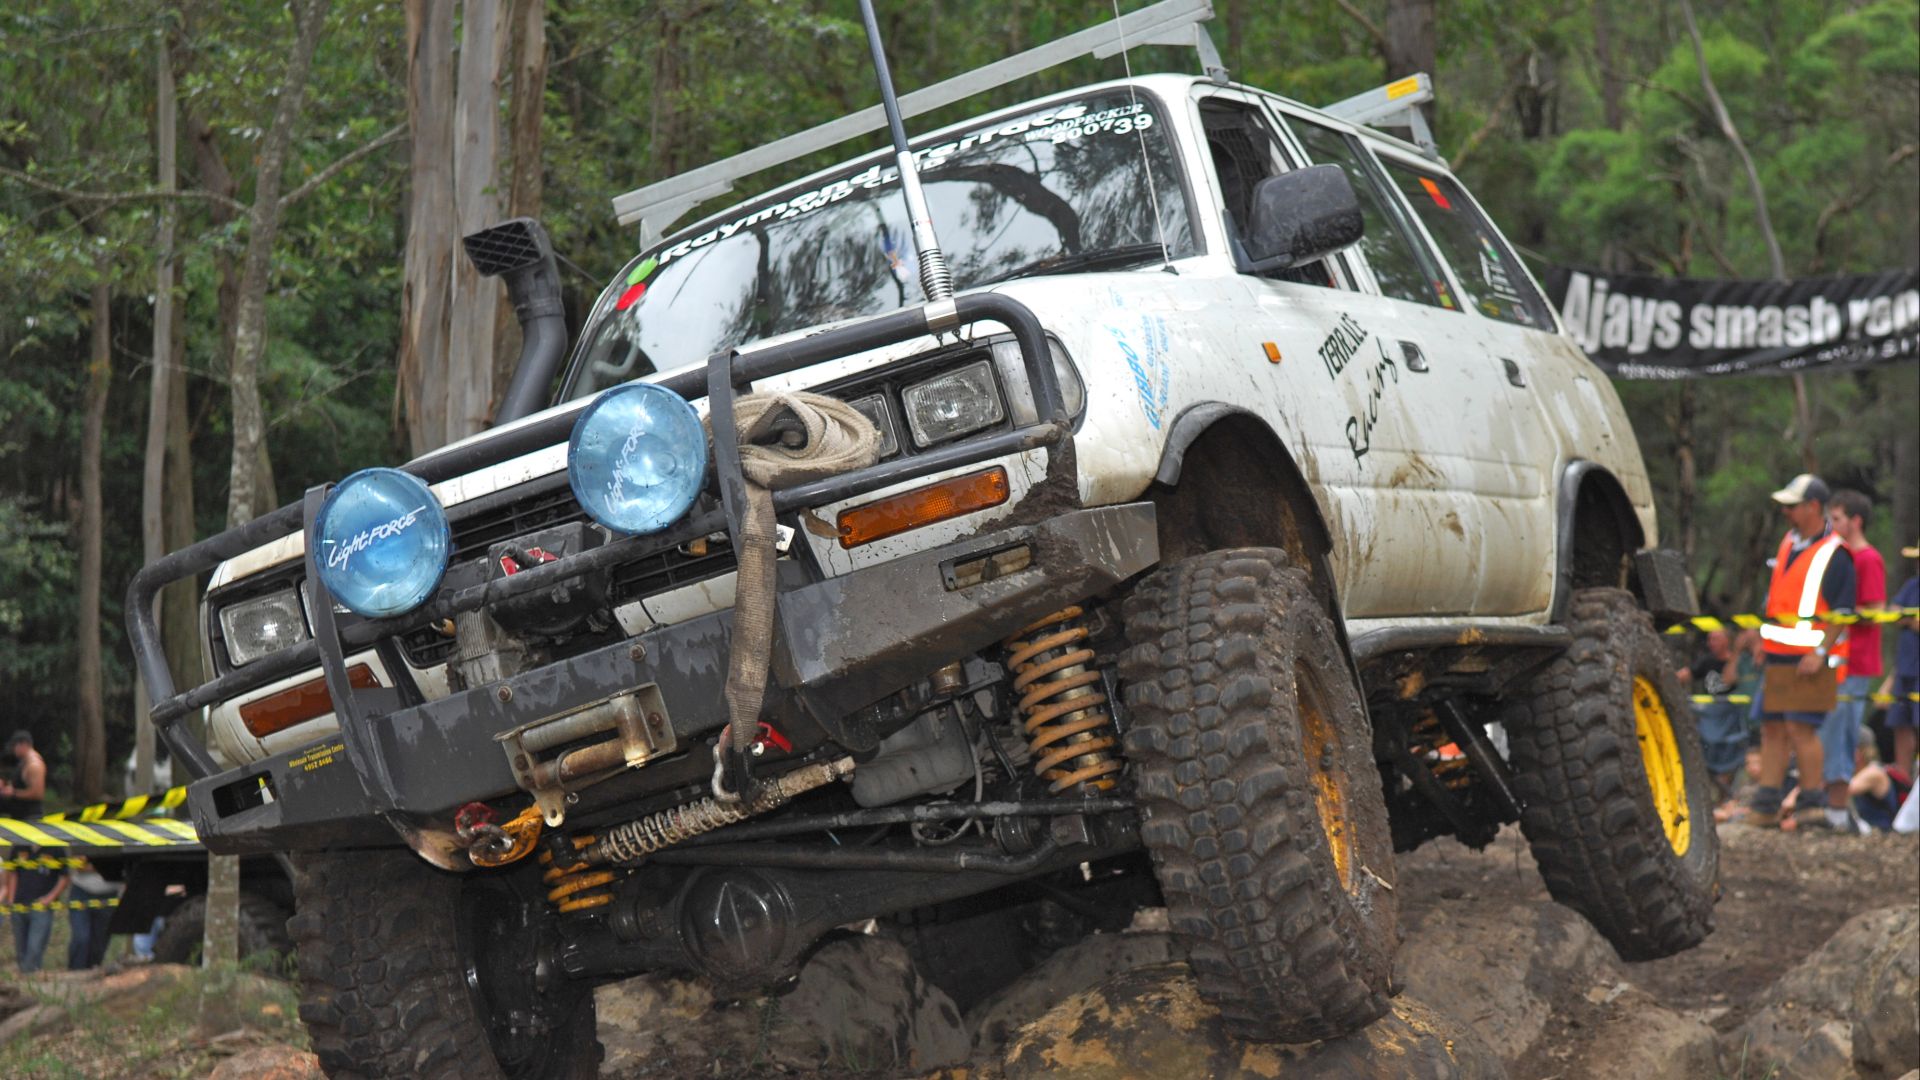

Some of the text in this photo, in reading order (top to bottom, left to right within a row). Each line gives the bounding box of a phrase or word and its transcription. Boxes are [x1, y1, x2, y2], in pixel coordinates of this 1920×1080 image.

[1024, 103, 1144, 141] WOODPECKER
[658, 105, 1088, 266] Raymond Terrace
[780, 187, 854, 220] 4WD
[1317, 312, 1369, 381] TERRACE
[1561, 271, 1683, 354] Ajays
[1687, 295, 1843, 350] smash
[1346, 336, 1398, 471] Racing
[327, 504, 427, 572] LightFORCE
